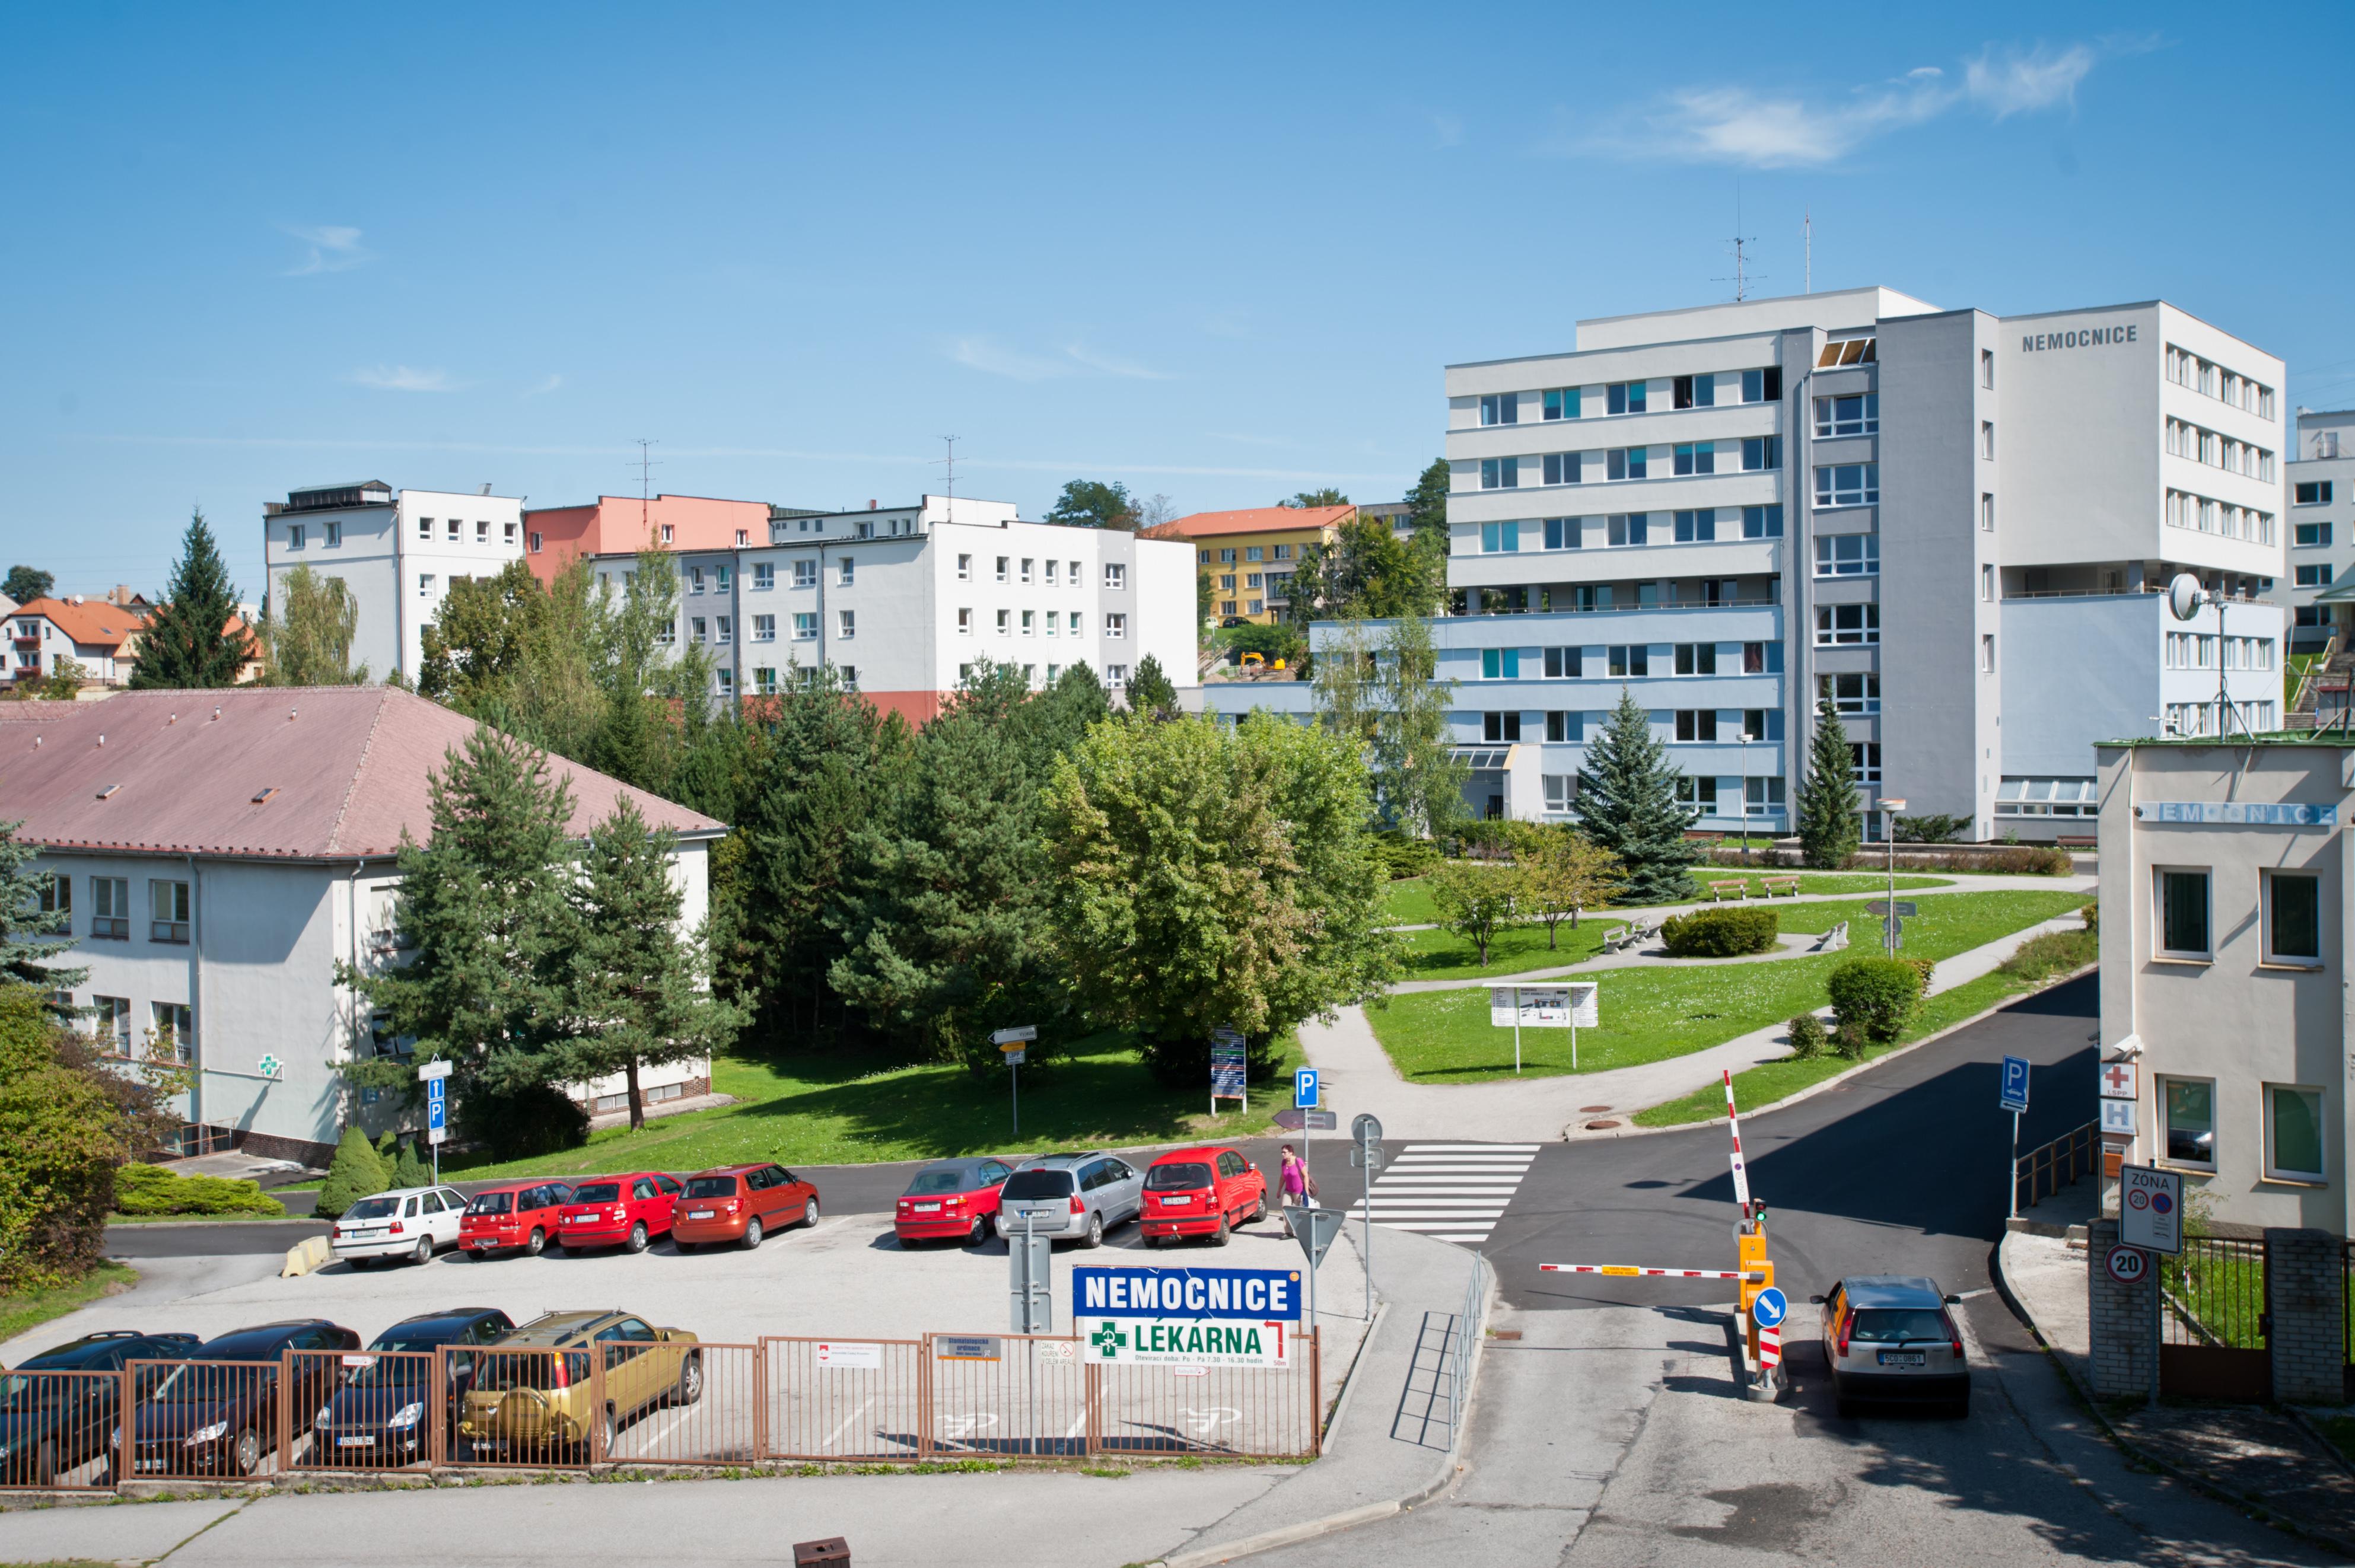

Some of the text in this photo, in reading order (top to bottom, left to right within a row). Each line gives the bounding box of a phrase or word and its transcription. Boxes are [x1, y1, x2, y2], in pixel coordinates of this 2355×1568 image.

[2022, 324, 2138, 352] NEMOCNICE
[2143, 803, 2334, 824] EMOCNICE
[1301, 1073, 1314, 1096] P
[2008, 1062, 2023, 1086] P
[432, 1103, 441, 1121] P
[2106, 1103, 2129, 1126] H
[2131, 1172, 2170, 1190] ZÓNA
[2133, 1194, 2145, 1205] 20
[2116, 1255, 2138, 1273] 20
[1085, 1276, 1288, 1311] NEMOCNICE
[1135, 1317, 1262, 1355] LÉKÁRNA
